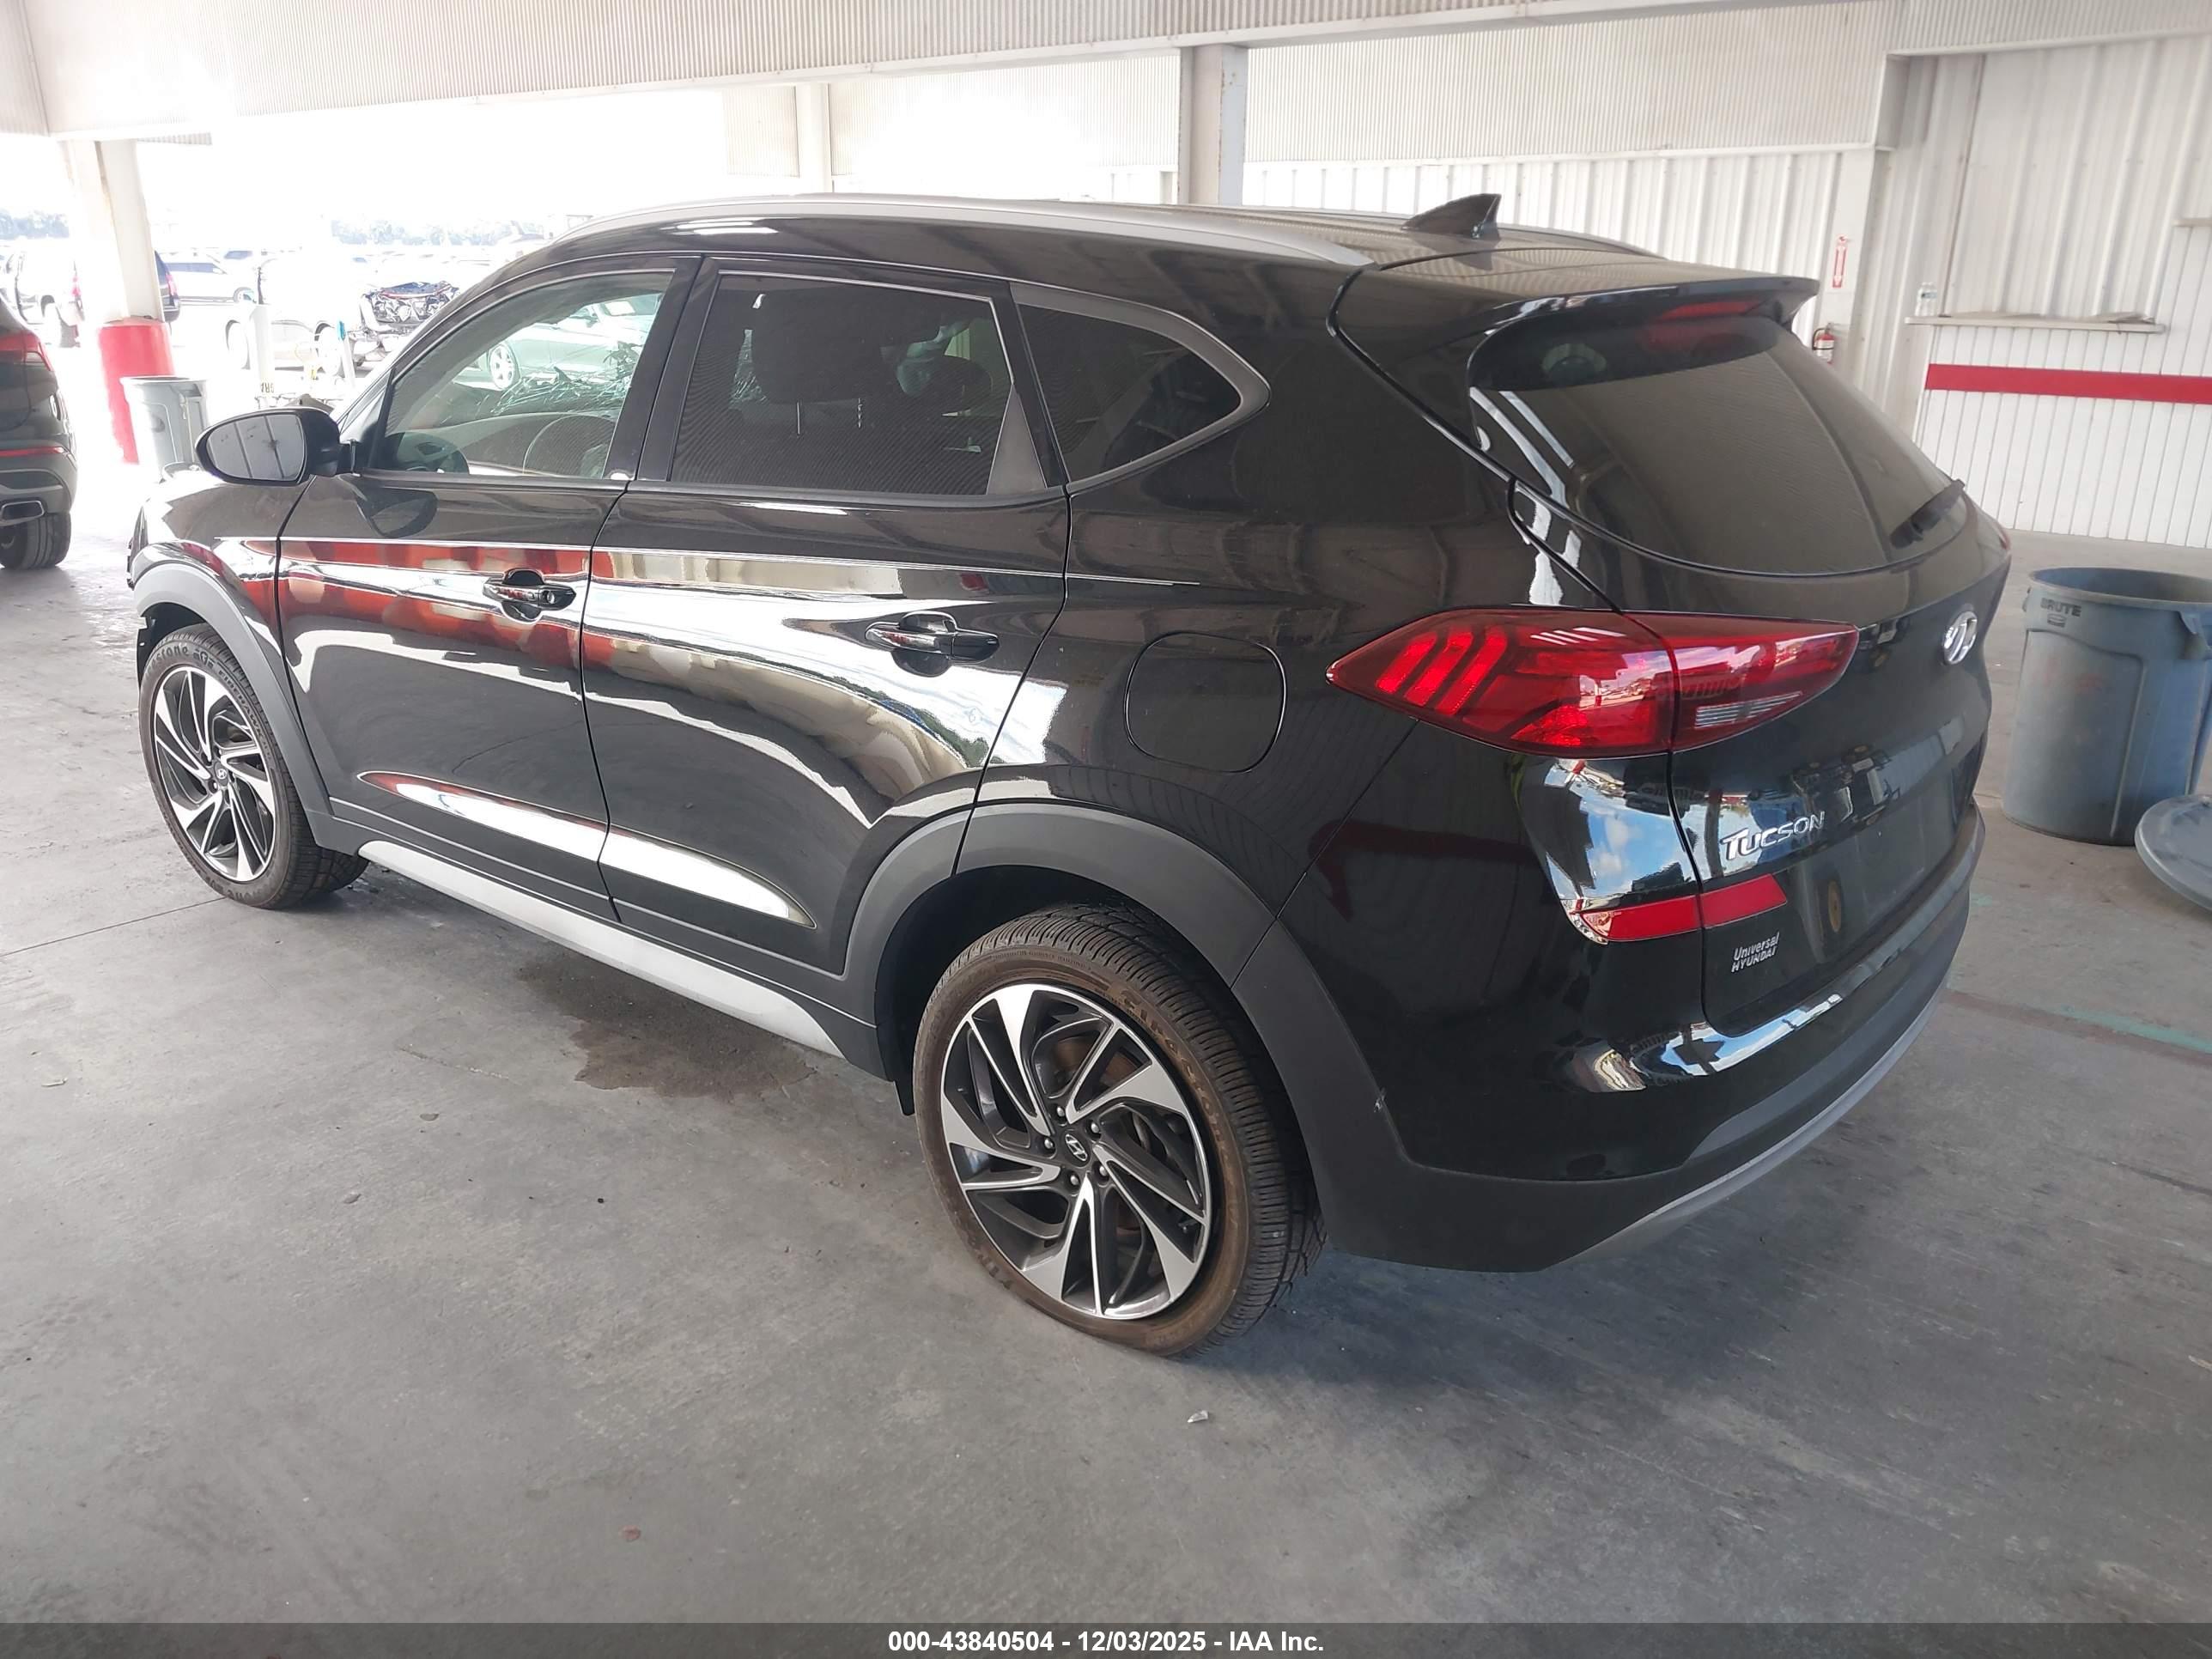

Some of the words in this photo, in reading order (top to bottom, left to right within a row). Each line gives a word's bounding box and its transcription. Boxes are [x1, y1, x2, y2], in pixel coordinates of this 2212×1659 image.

[2040, 598, 2082, 617] BRUTE
[1731, 945, 1778, 973] HYUNDAI
[1733, 932, 1779, 961] Universal
